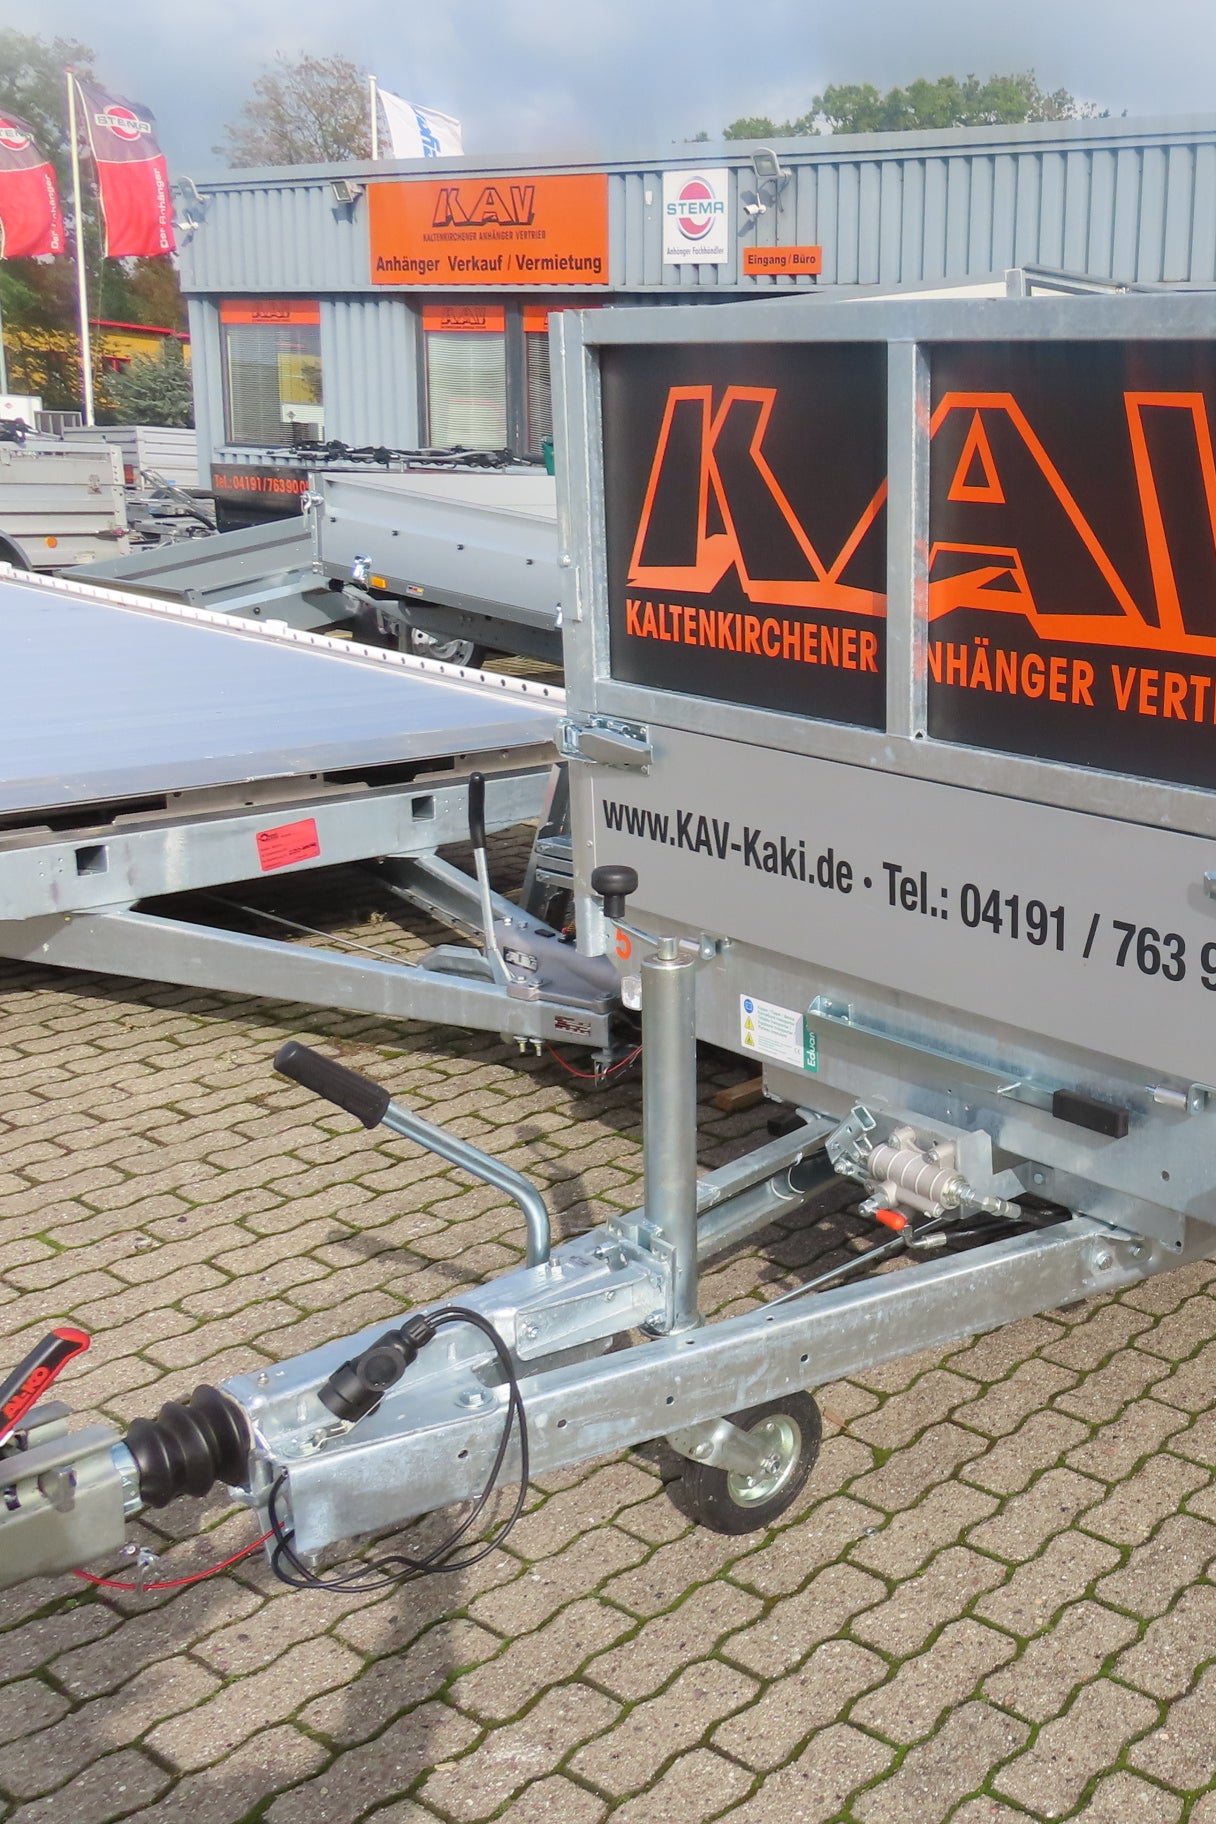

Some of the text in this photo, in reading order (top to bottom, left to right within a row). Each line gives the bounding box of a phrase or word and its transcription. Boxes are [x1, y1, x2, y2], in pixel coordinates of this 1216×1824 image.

[96, 115, 150, 132] STEMA
[154, 168, 170, 249] Der Anhänger
[432, 186, 535, 227] KAV
[667, 202, 724, 216] STEMA
[51, 230, 60, 249] Der
[479, 230, 513, 241] ANHÄNGER
[516, 230, 546, 240] VERTRIEB
[667, 247, 691, 258] Anhänger
[748, 254, 786, 266] Eingang
[792, 253, 816, 265] Büro
[376, 256, 440, 275] Anhänger
[447, 254, 503, 271] Verkauf
[515, 254, 602, 274] Vermietung
[626, 598, 879, 672] KALTENKIRCHENER
[928, 636, 1094, 706] NHÄNGER
[602, 799, 853, 894] www.KAV-Kaki.de
[882, 861, 948, 921] Tel.:
[960, 883, 1065, 951] 04191
[1113, 919, 1186, 982] 763
[807, 1025, 816, 1067] Eduar
[3, 1365, 51, 1420] AL-KO
